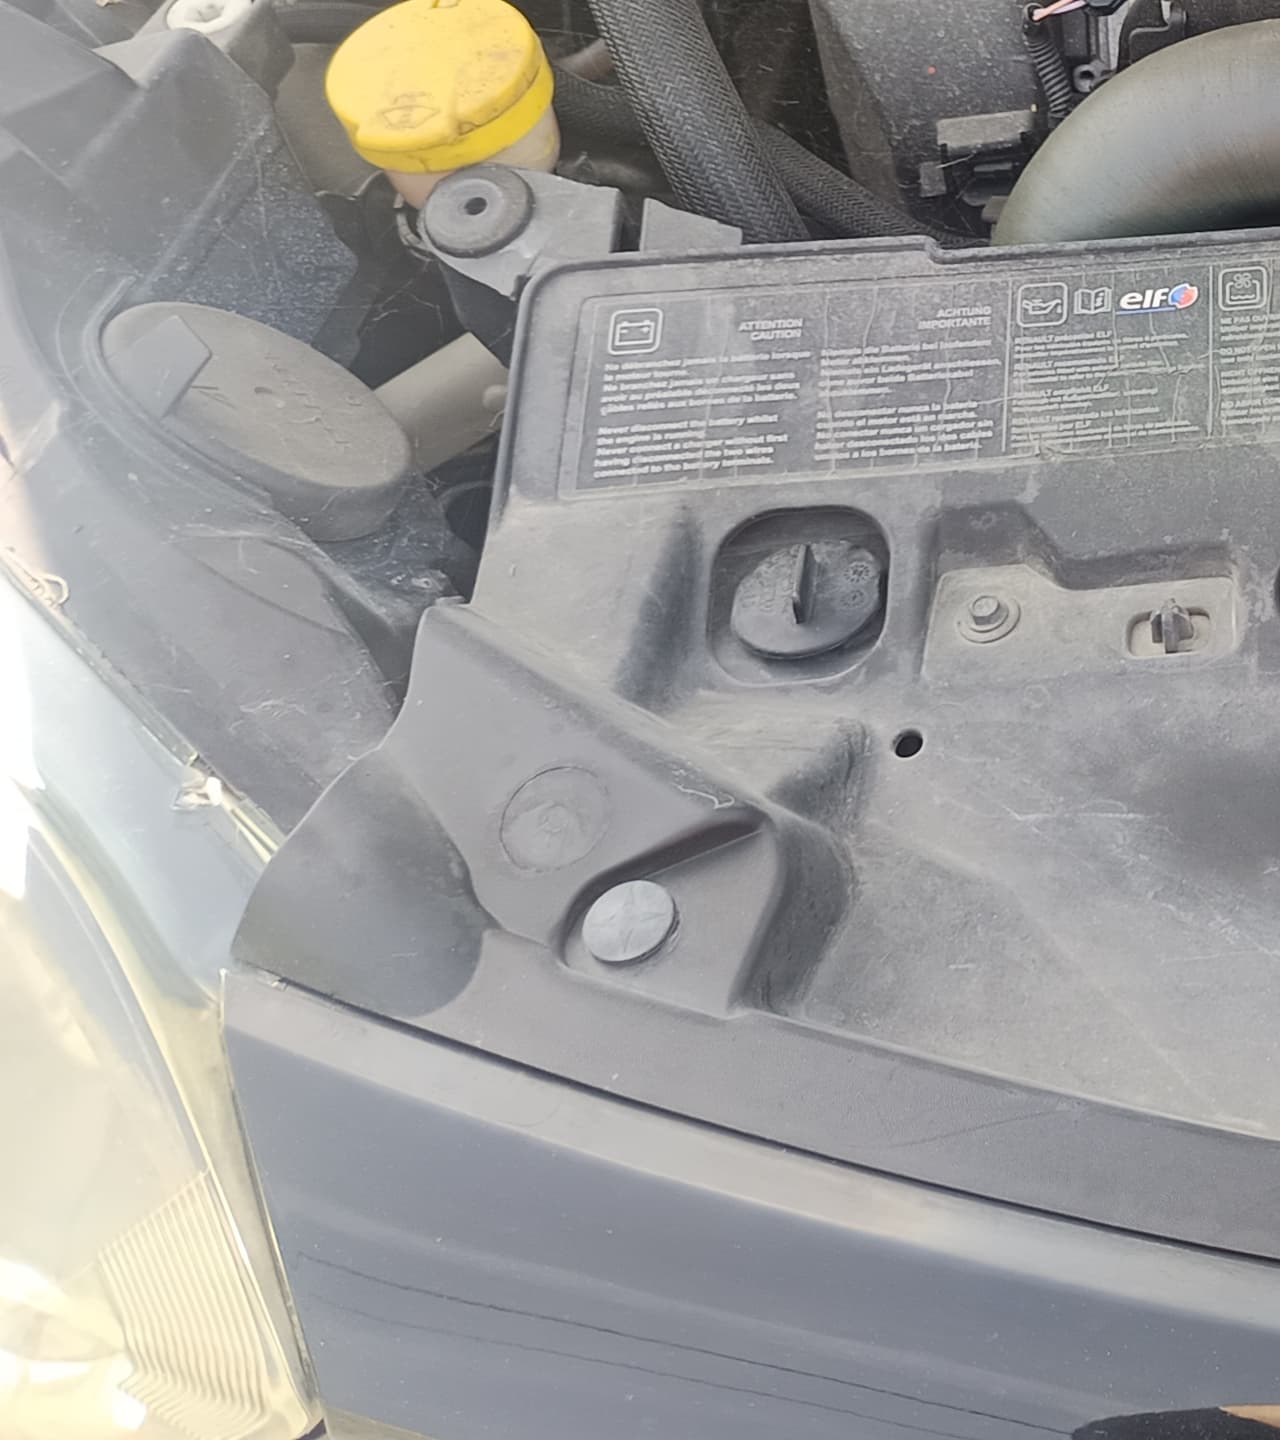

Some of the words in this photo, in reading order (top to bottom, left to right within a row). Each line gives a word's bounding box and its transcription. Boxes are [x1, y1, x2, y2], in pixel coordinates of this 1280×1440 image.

[1119, 288, 1169, 310] elf
[936, 306, 991, 318] ACHTUNG
[738, 318, 803, 332] ATTENTION
[918, 316, 991, 330] IMPORTANTE
[751, 329, 802, 341] CAUTION
